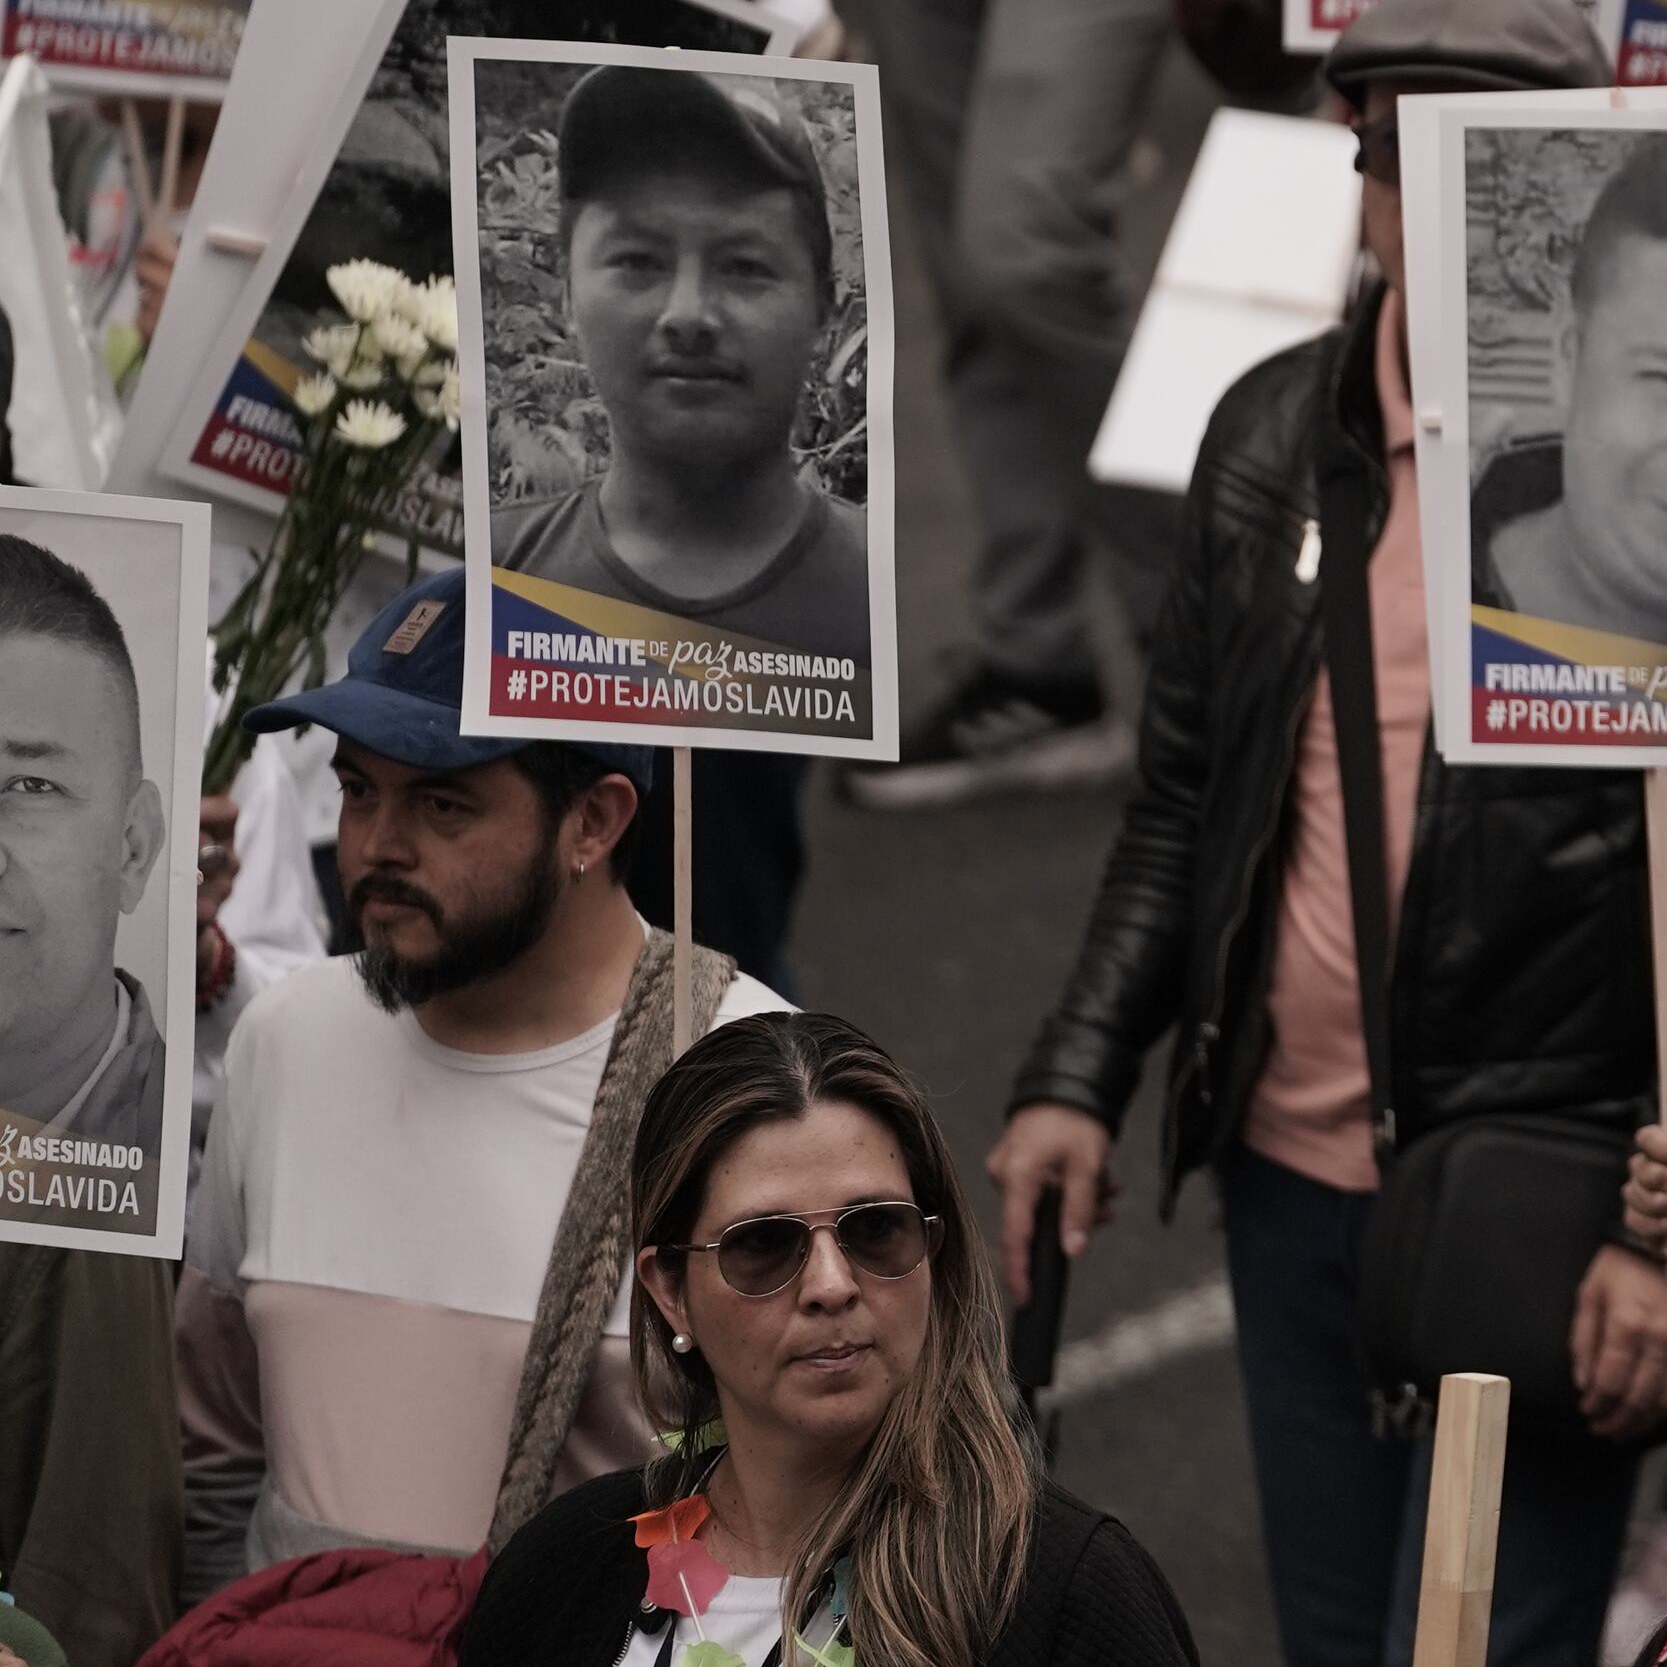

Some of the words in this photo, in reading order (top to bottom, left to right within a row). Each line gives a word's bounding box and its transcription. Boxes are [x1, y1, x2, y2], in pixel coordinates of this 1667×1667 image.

[508, 630, 646, 666] FIRMANTE
[650, 640, 668, 657] DE
[668, 639, 733, 680] paz
[734, 654, 855, 680] ASESINADO
[507, 669, 855, 722] #PROTEJAMOSLAVIDA
[1485, 663, 1627, 693] FIRMANTE
[1629, 667, 1649, 683] DE
[17, 1136, 143, 1171] ASESINADO
